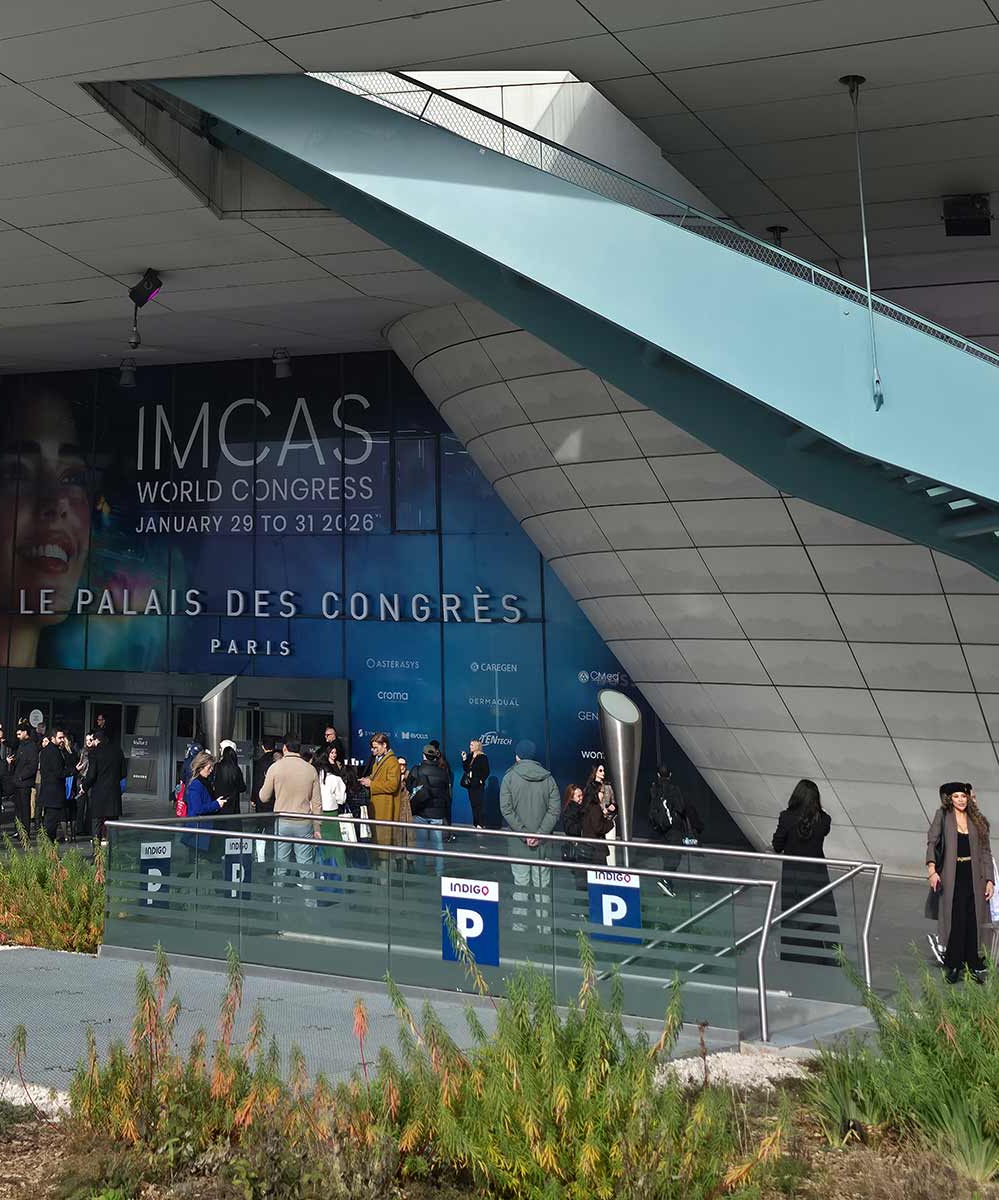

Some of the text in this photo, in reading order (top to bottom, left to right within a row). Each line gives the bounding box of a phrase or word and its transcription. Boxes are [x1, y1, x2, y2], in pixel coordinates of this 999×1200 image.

[136, 393, 374, 471] IMCAS
[137, 476, 374, 504] WORLD CONGRESS
[135, 514, 375, 534] JANUARY 29 TO 31 2026
[19, 586, 523, 624] LE PALAIS DES CONGRÈS
[210, 639, 292, 657] PARIS
[376, 659, 420, 669] ASTERASYS
[481, 663, 518, 672] CAREGEN
[377, 691, 409, 700] croma
[468, 697, 520, 706] DERMAQUAL
[144, 845, 168, 856] INDIGO
[450, 882, 490, 896] INDIGO
[602, 894, 628, 927] P
[456, 908, 484, 945] P
